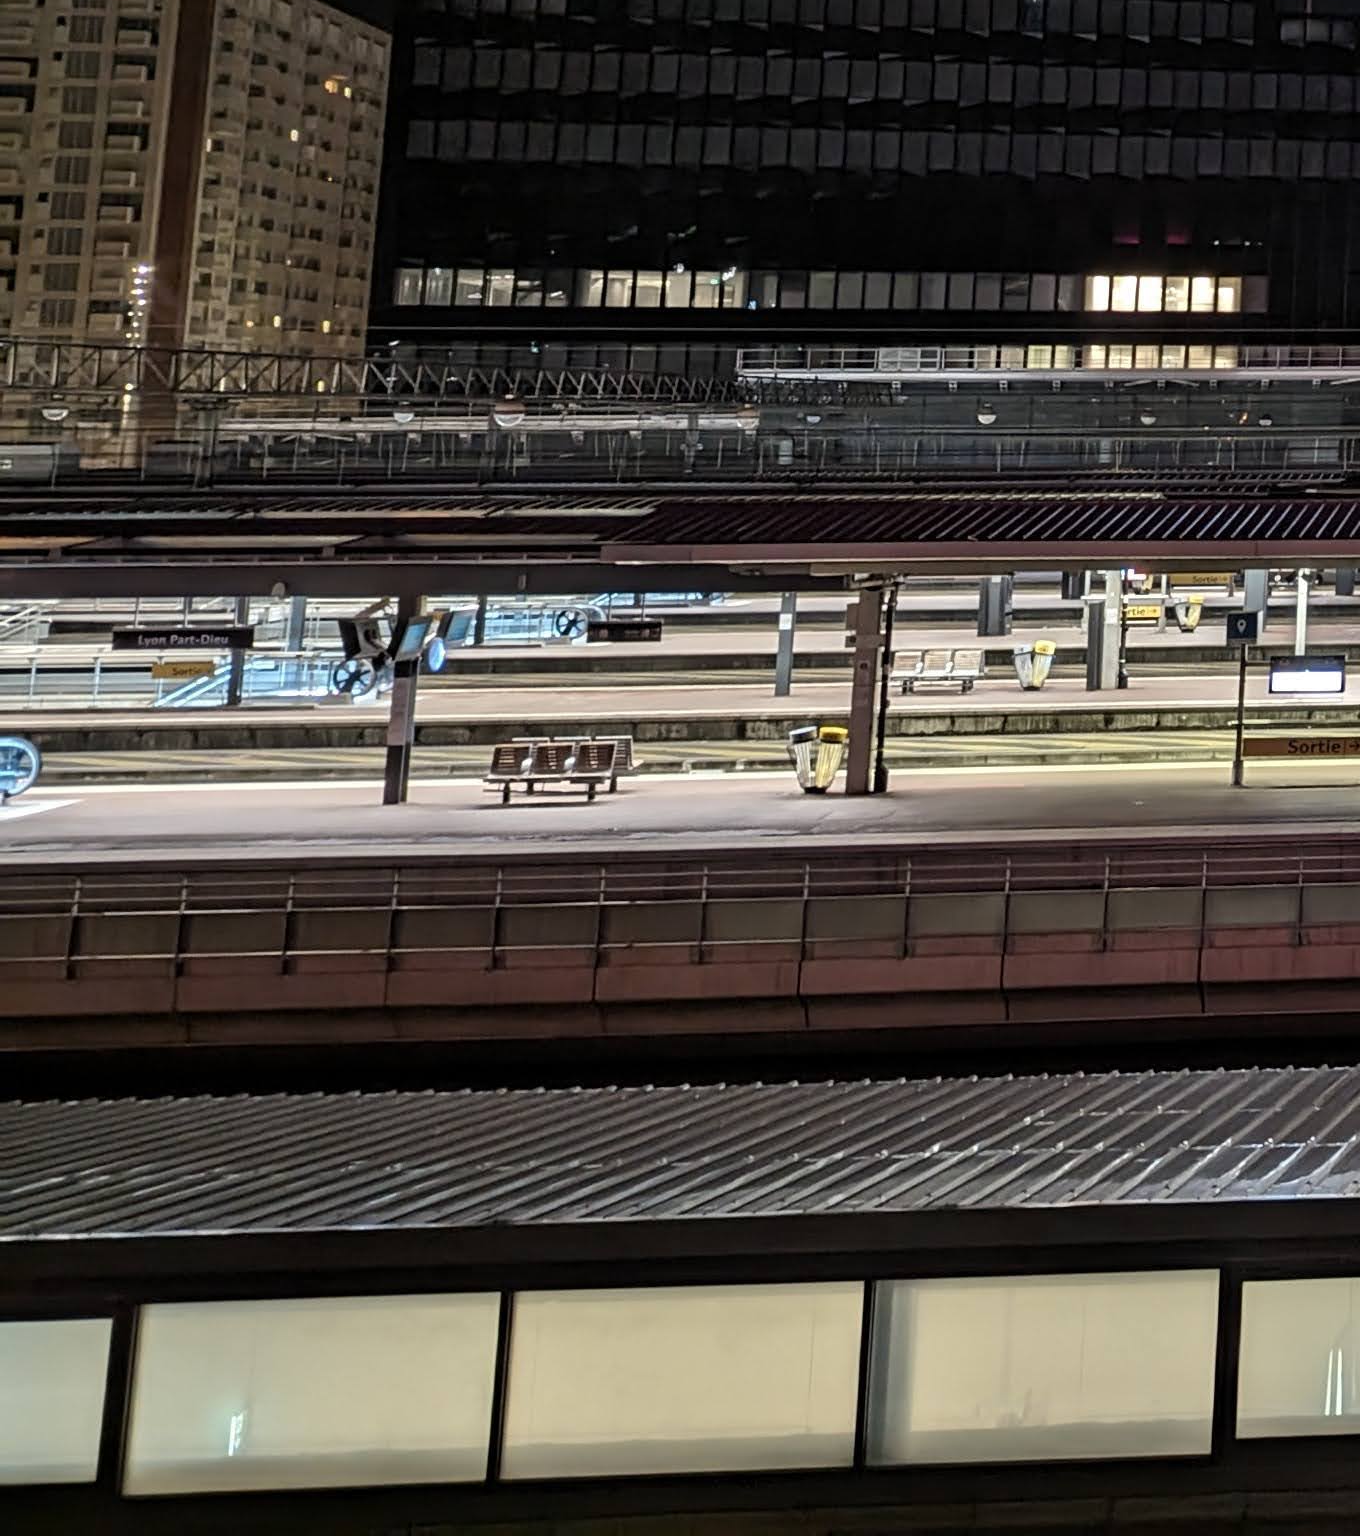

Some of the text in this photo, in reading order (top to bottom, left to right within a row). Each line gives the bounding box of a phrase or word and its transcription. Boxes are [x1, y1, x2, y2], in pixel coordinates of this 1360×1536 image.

[1193, 575, 1218, 584] Sortie
[138, 634, 229, 647] Lyon Part-Dieu
[1287, 740, 1341, 754] Sortie
